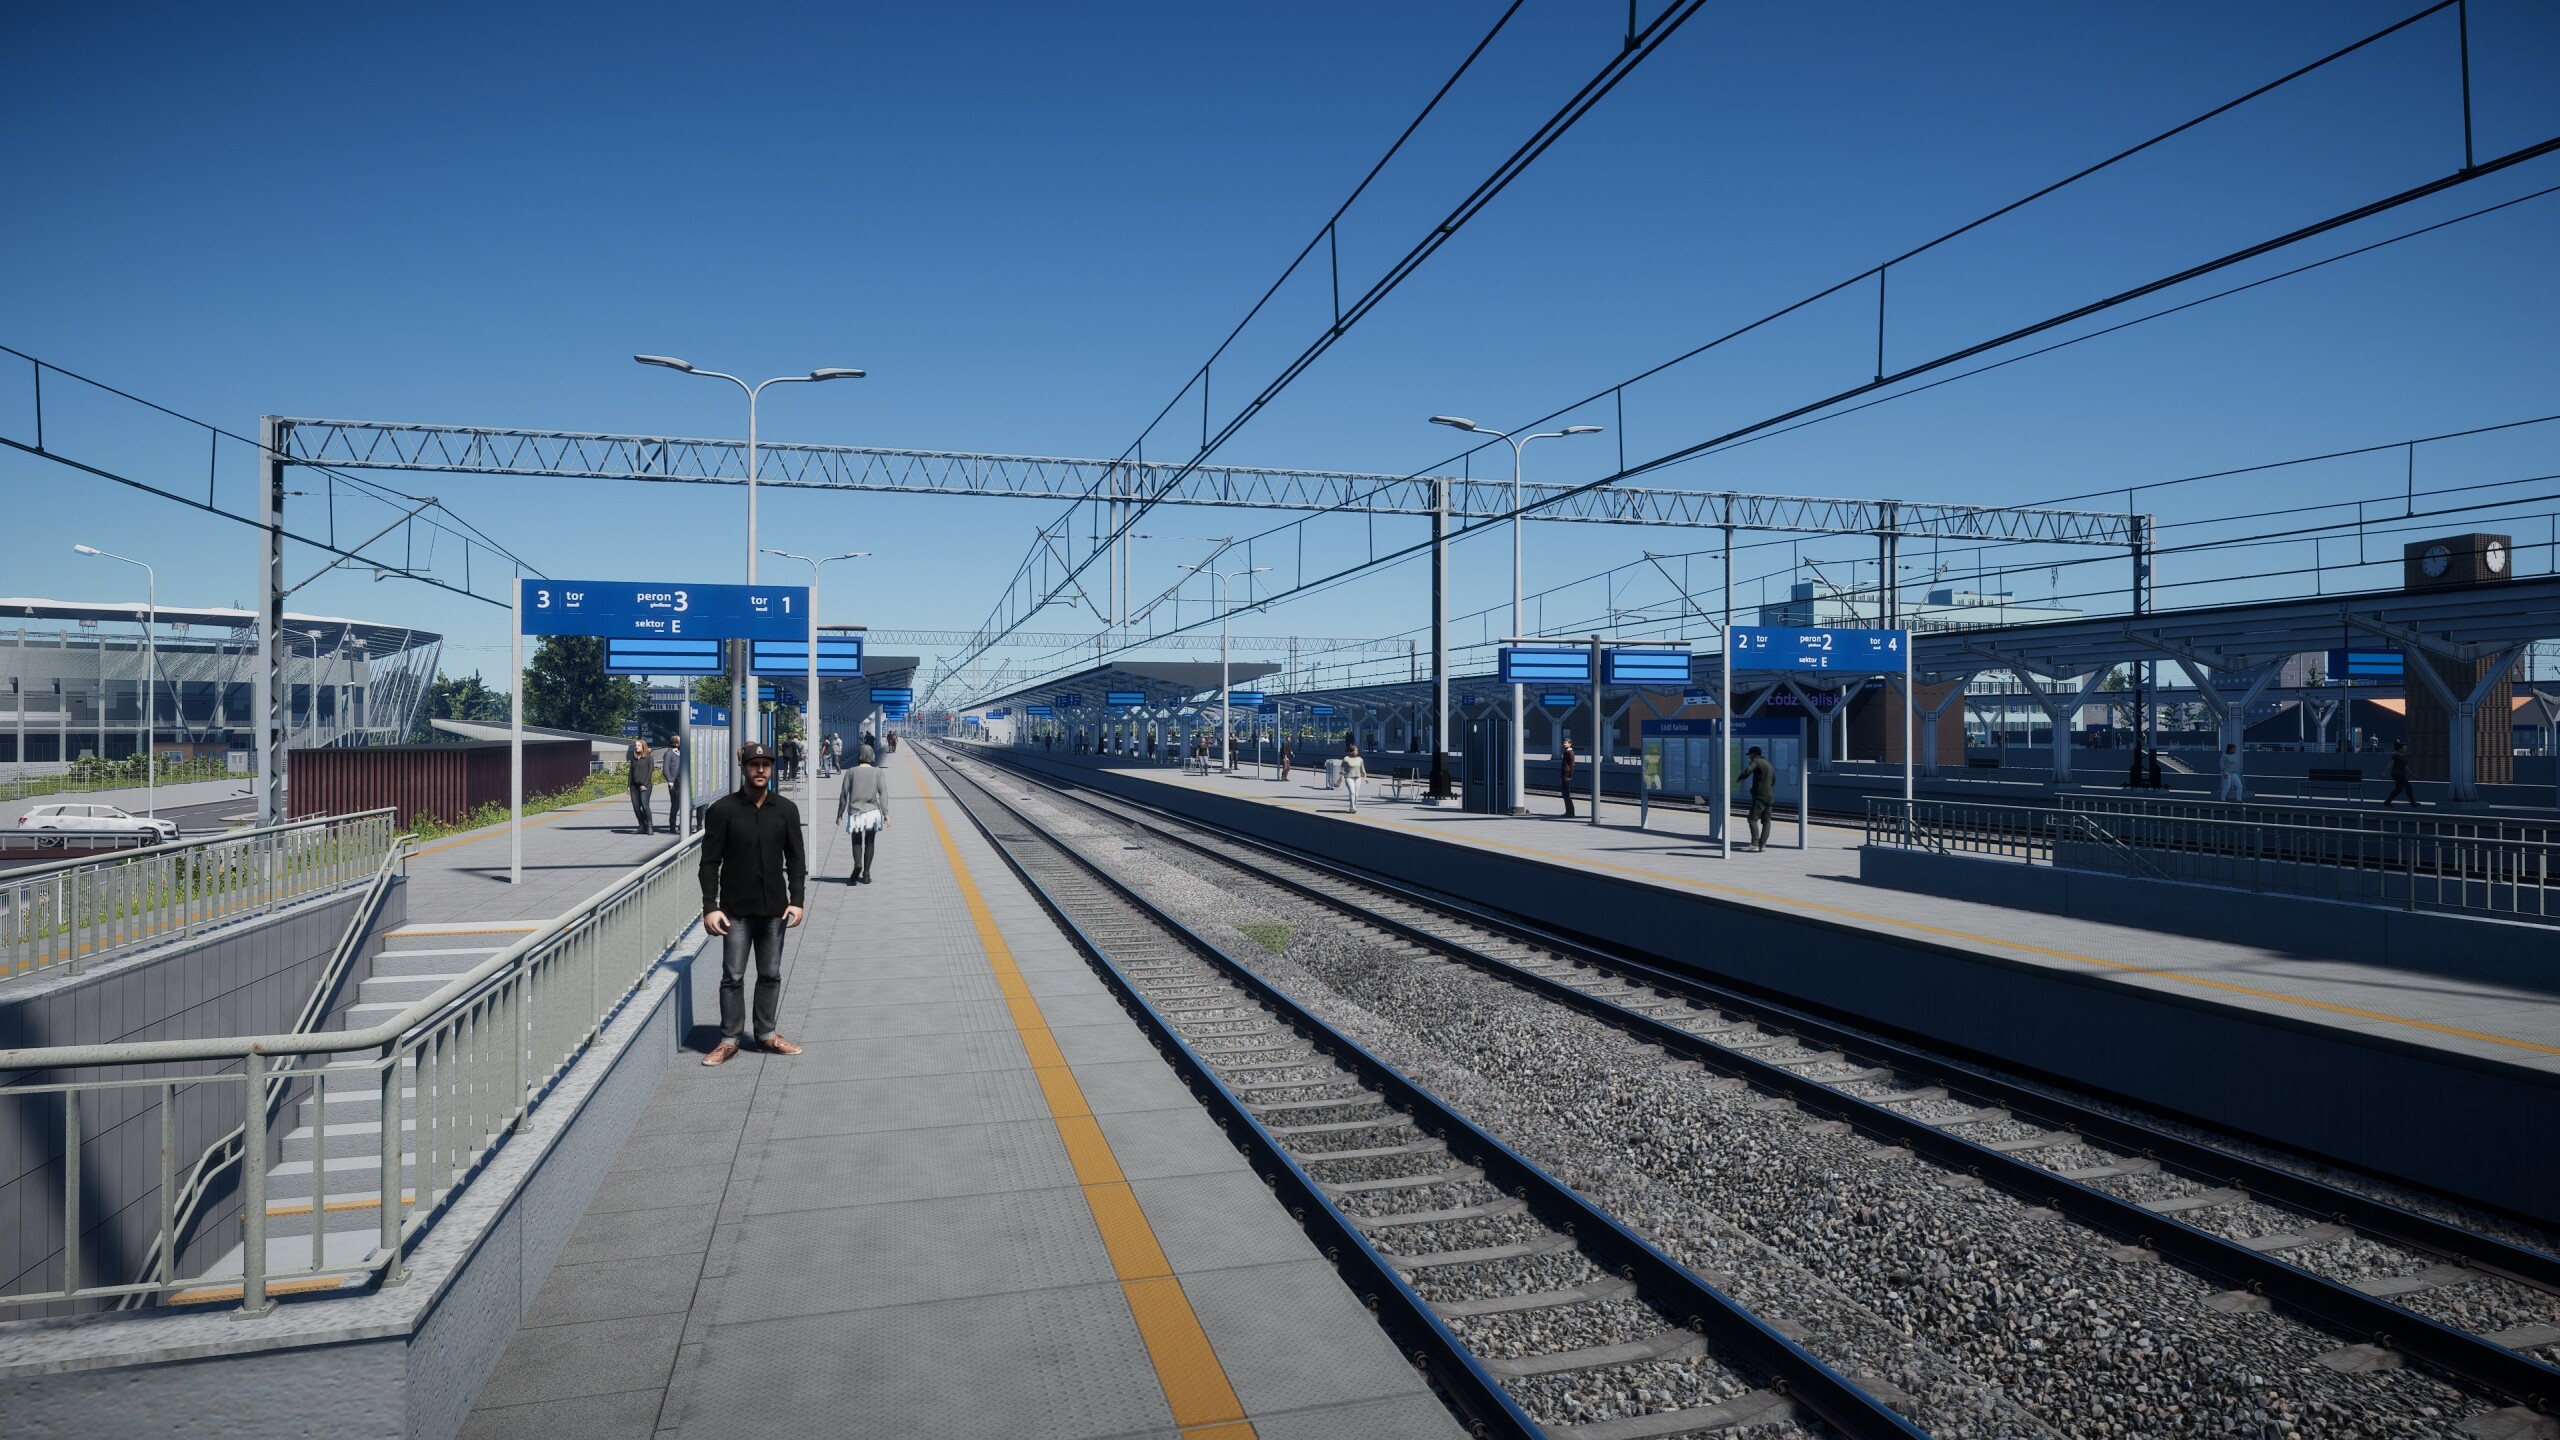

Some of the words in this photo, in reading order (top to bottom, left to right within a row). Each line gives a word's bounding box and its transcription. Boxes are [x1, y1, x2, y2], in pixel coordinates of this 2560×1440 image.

[537, 590, 550, 608] 3
[566, 591, 584, 600] tor
[637, 592, 671, 603] peron
[673, 590, 689, 612] 3
[751, 595, 768, 605] tor
[782, 596, 791, 614] 1
[635, 618, 665, 628] sektor
[671, 619, 681, 633] E
[1738, 634, 1748, 649] 2
[1756, 635, 1768, 643] tor
[1800, 635, 1822, 644] peron
[1822, 633, 1832, 651] 2
[1869, 637, 1881, 645] tor
[1888, 637, 1898, 651] 4
[1798, 656, 1817, 664] sektor
[1821, 656, 1828, 667] E
